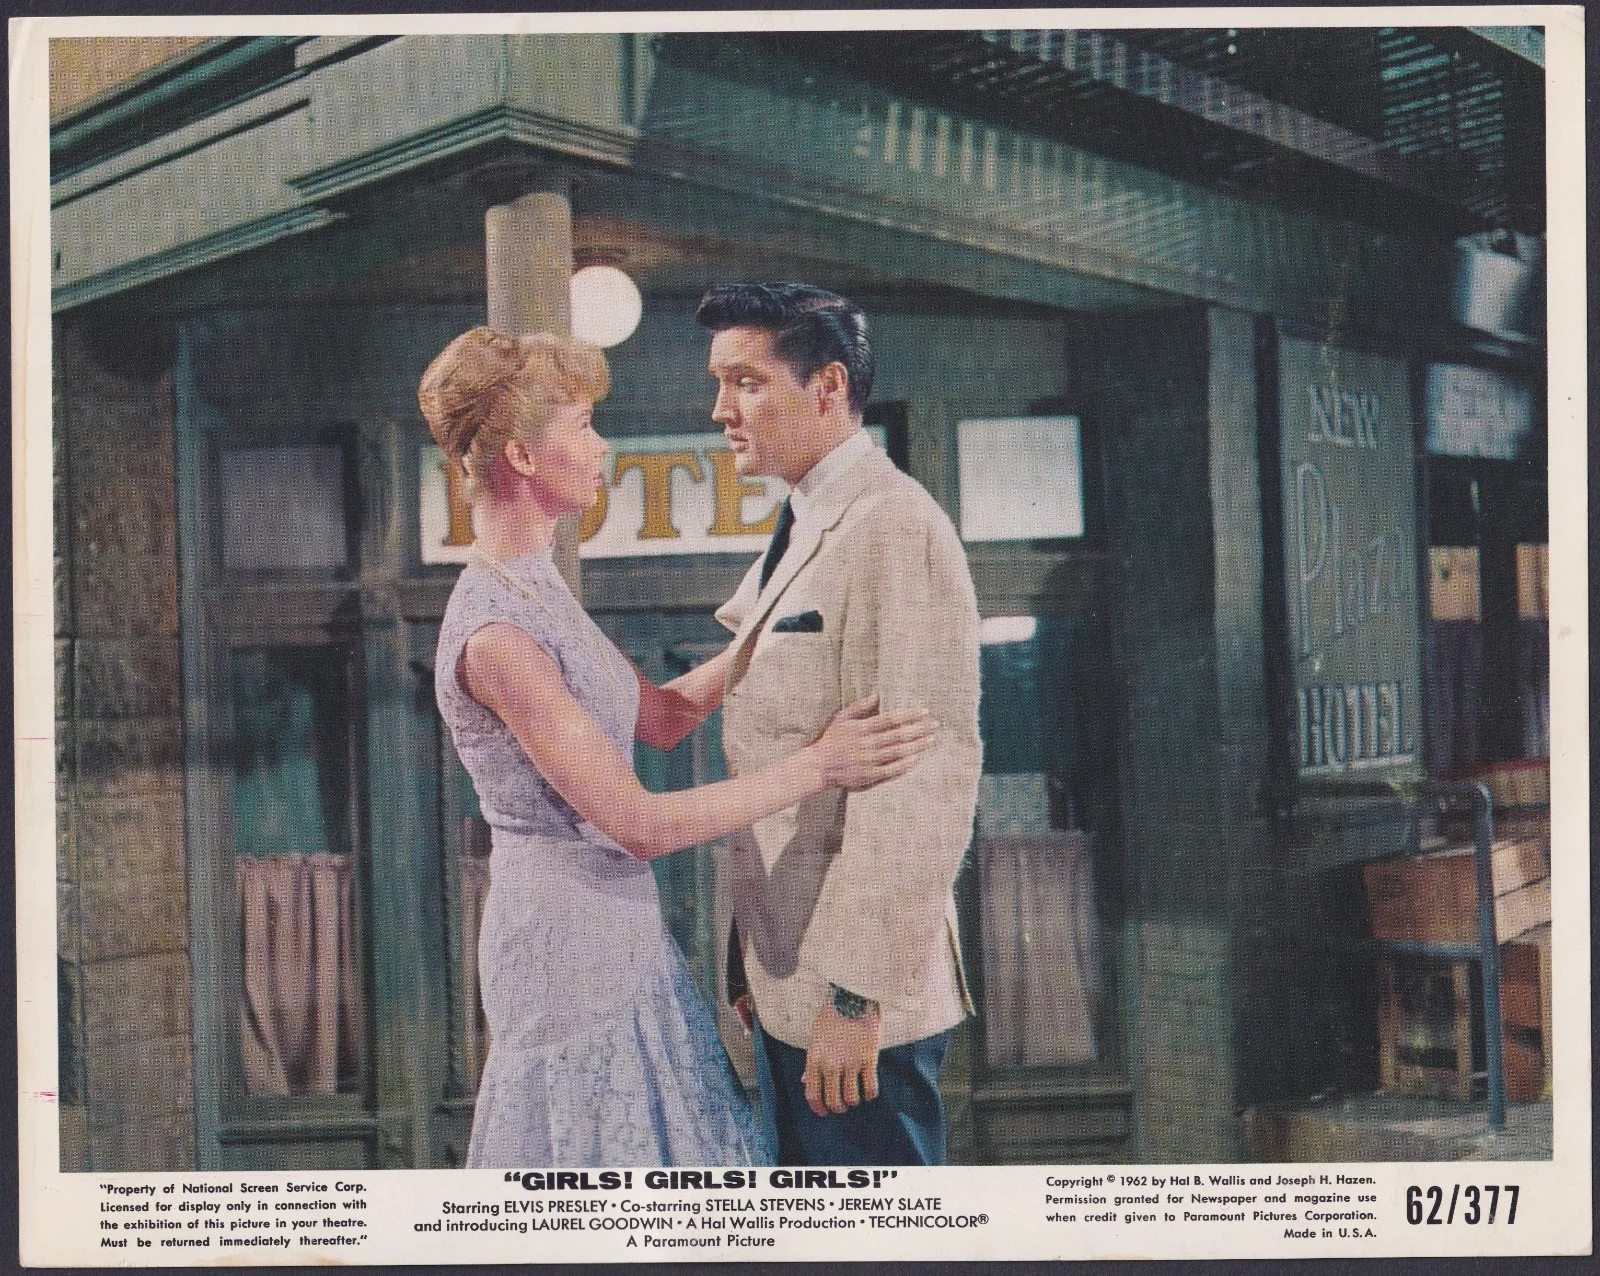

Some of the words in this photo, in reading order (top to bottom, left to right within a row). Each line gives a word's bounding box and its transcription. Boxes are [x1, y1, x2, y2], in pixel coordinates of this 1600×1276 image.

[1307, 384, 1380, 448] NEW
[1298, 682, 1413, 774] HOTEL
[162, 1183, 175, 1194] of
[182, 1182, 233, 1194] National
[240, 1182, 279, 1194] Screen
[286, 1181, 328, 1193] Service
[334, 1181, 367, 1194] Corp.
[644, 1170, 757, 1190] GIRLS!
[1046, 1176, 1104, 1189] Copyright
[1120, 1176, 1148, 1187] 1962
[1151, 1176, 1167, 1189] by
[1170, 1175, 1190, 1186] Hal
[1193, 1175, 1205, 1186] B.
[1208, 1175, 1246, 1186] Wallis
[1249, 1175, 1272, 1186] and
[1275, 1174, 1316, 1188] Joseph
[1319, 1174, 1332, 1185] H.
[1336, 1174, 1376, 1185] Hazen.
[100, 1201, 149, 1213] Licensed
[155, 1201, 173, 1212] for
[178, 1200, 221, 1214] display
[226, 1200, 252, 1214] only
[257, 1200, 269, 1211] in
[274, 1199, 337, 1211] connection
[342, 1199, 367, 1210] with
[442, 1201, 500, 1217] Starring
[504, 1200, 544, 1214] ELVIS
[548, 1199, 608, 1213] PRESLEY
[620, 1199, 701, 1215] Co-starring
[705, 1198, 756, 1212] STELLA
[759, 1198, 826, 1212] STEVENS
[838, 1197, 894, 1211] JEREMY
[897, 1197, 942, 1211] SLATE
[1045, 1193, 1107, 1205] Permission
[1113, 1193, 1160, 1207] granted
[1166, 1193, 1184, 1204] for
[1191, 1193, 1258, 1206] Newspaper
[1264, 1192, 1287, 1203] and
[1294, 1192, 1351, 1205] magazine
[1357, 1194, 1377, 1203] use
[1406, 1183, 1520, 1226] 62/377
[99, 1219, 119, 1230] the
[123, 1219, 182, 1230] exhibition
[187, 1218, 200, 1229] of
[204, 1218, 225, 1229] this
[230, 1218, 271, 1231] picture
[275, 1217, 287, 1228] in
[291, 1220, 318, 1231] your
[322, 1217, 368, 1228] theatre.
[413, 1219, 442, 1232] and
[446, 1217, 528, 1234] introducing
[532, 1218, 586, 1231] LAUREL
[588, 1217, 673, 1231] GOODWIN
[685, 1216, 699, 1230] A
[701, 1216, 726, 1230] Hal
[729, 1216, 775, 1230] Wallis
[779, 1216, 856, 1229] Production
[1045, 1212, 1076, 1222] when
[1084, 1211, 1117, 1223] credit
[1124, 1211, 1157, 1225] given
[1164, 1212, 1176, 1222] to
[1183, 1211, 1246, 1222] Paramount
[1253, 1210, 1298, 1222] Pictures
[1304, 1210, 1377, 1223] Corporation.
[1283, 1228, 1317, 1239] Made
[1321, 1227, 1333, 1238] in
[100, 1237, 128, 1248] Must
[136, 1237, 152, 1248] be
[160, 1236, 210, 1247] returned
[219, 1235, 291, 1249] immediately
[626, 1234, 638, 1248] A
[644, 1234, 722, 1248] Paramount
[727, 1234, 775, 1247] Picture
